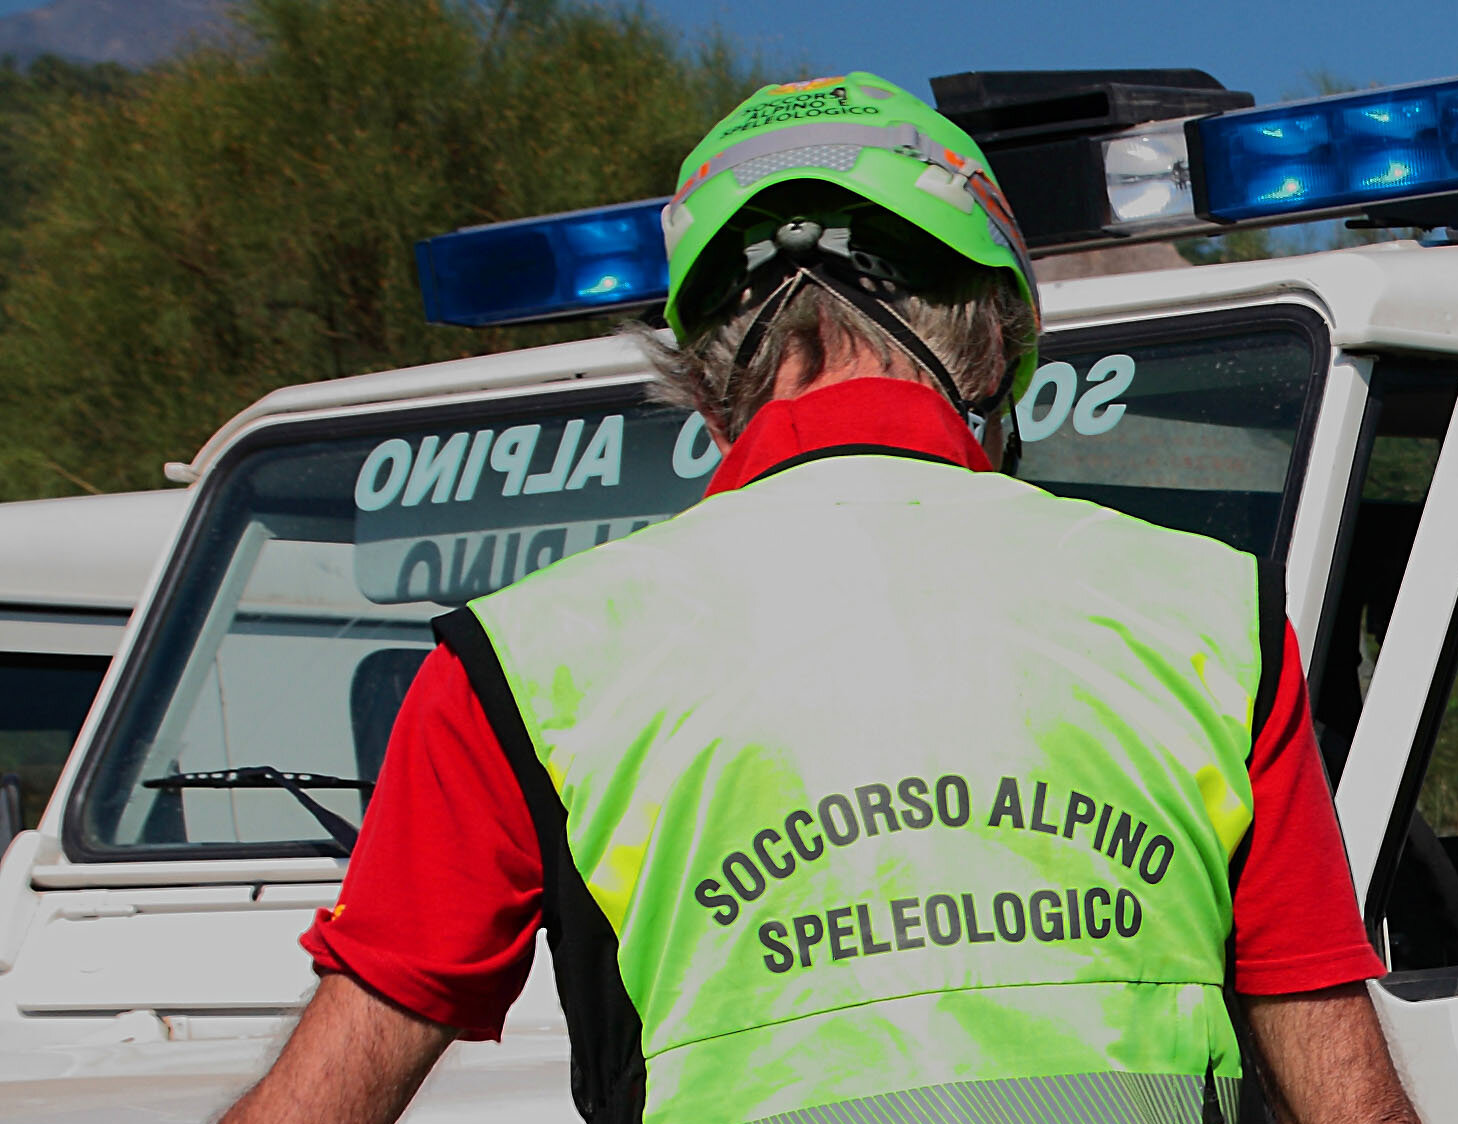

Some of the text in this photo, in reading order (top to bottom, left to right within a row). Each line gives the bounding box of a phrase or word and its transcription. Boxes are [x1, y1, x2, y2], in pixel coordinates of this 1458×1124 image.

[694, 775, 1176, 926] SOCCORSO ALPINO
[758, 888, 1142, 974] SPELEOLOGICO
